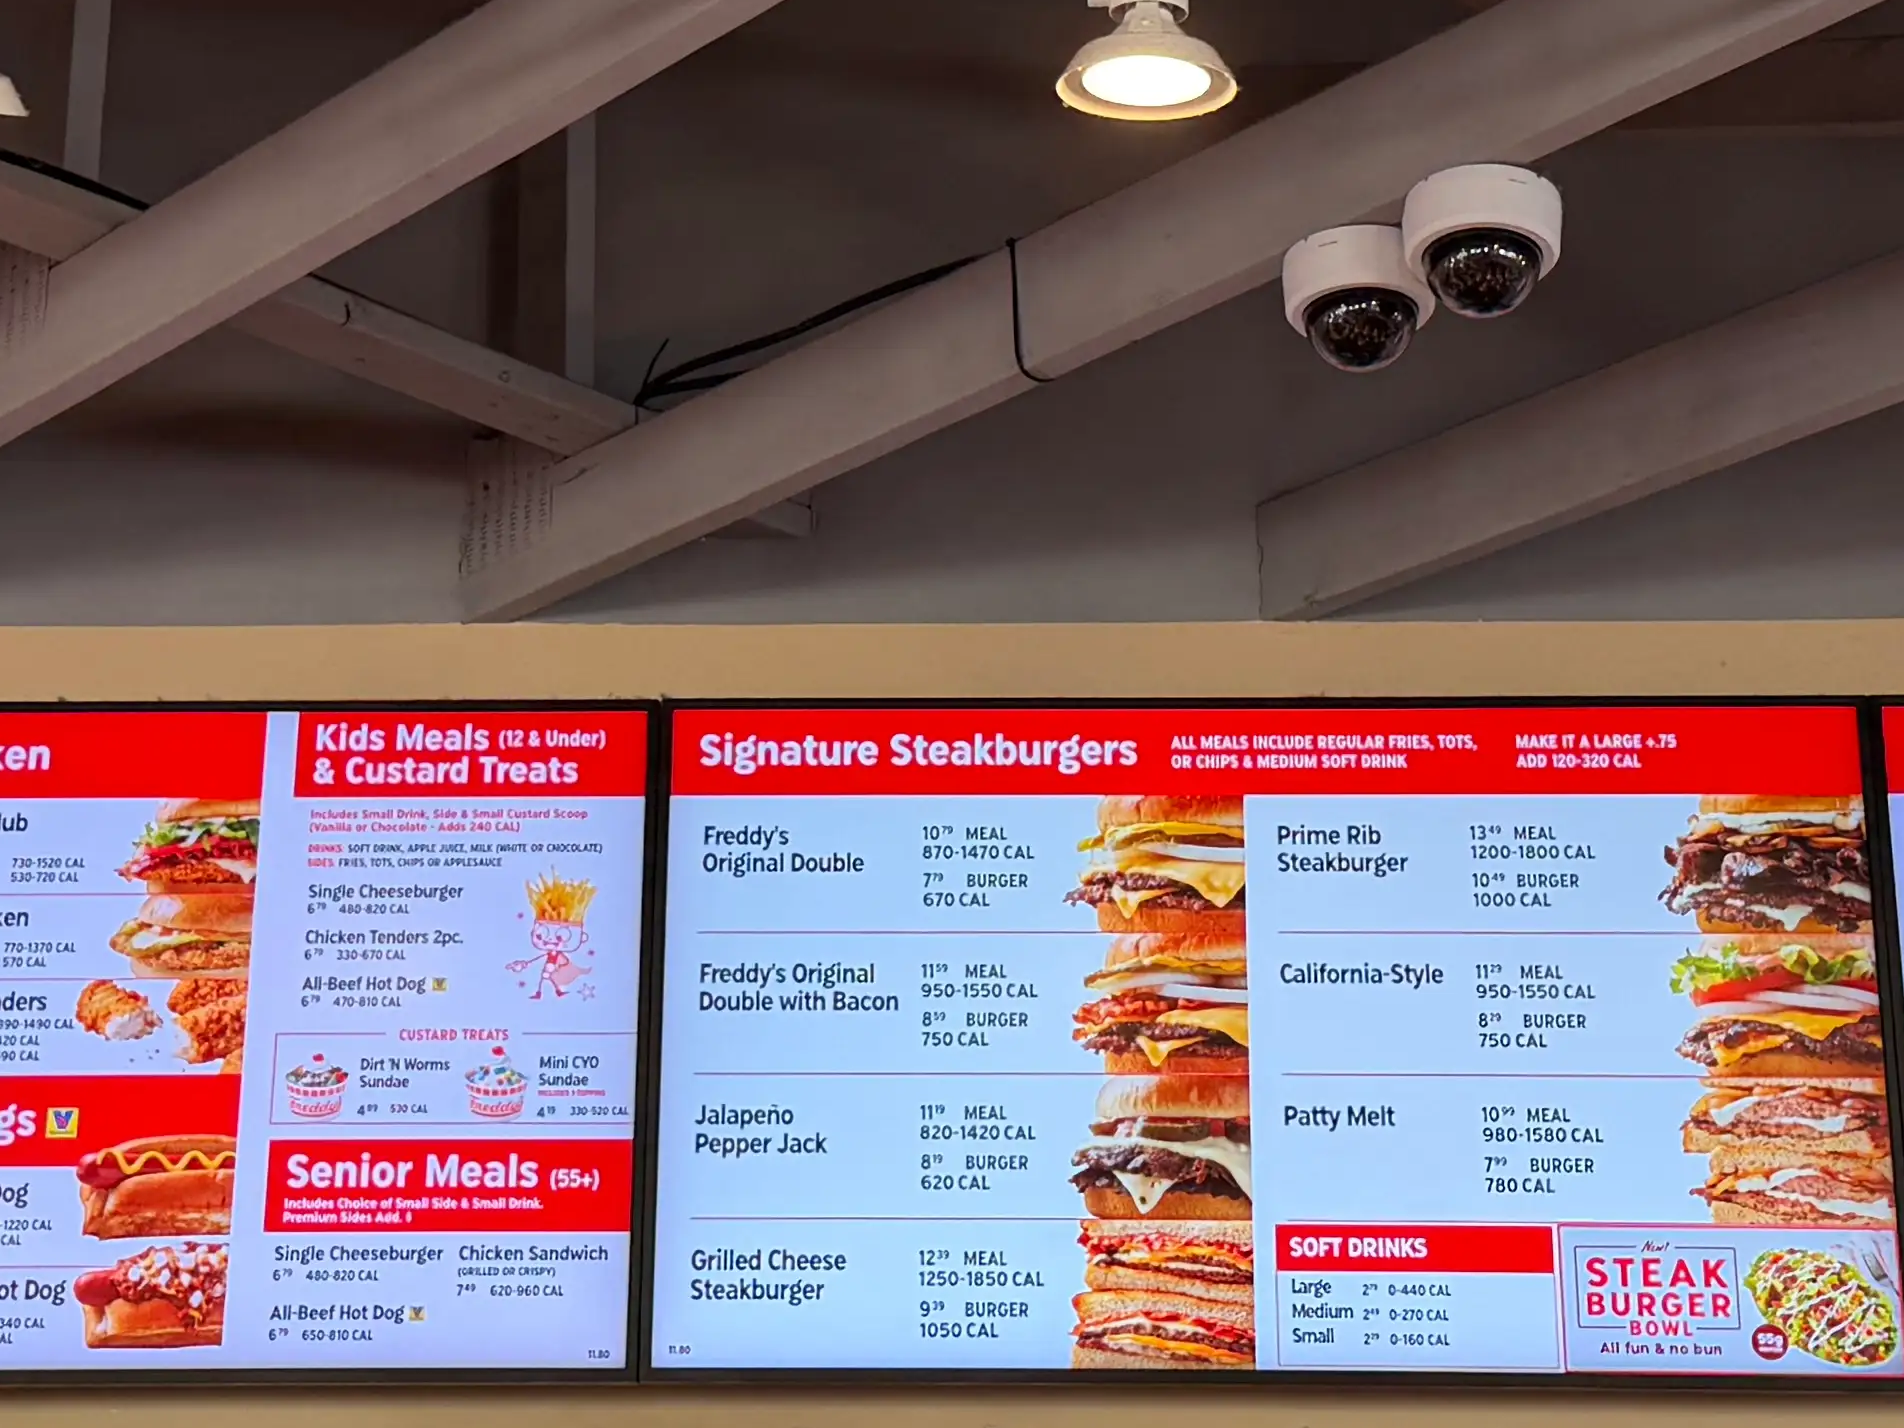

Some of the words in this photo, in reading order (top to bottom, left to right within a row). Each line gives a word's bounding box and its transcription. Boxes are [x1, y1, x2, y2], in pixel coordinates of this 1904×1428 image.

[317, 723, 384, 750] Kids
[397, 724, 489, 750] Meals
[700, 733, 878, 775] Signature
[890, 733, 1137, 774] Steakburgers
[314, 758, 334, 784] &
[346, 756, 468, 783] Custard
[480, 757, 577, 783] Treats
[704, 826, 788, 850] Freddy's
[1278, 825, 1340, 844] Prime
[1348, 825, 1381, 844] Rib
[703, 852, 783, 877] Original
[792, 853, 864, 872] Double
[923, 845, 999, 859] 870-1470
[1004, 845, 1034, 859] CAL
[1278, 852, 1408, 877] Steakburger
[967, 874, 1027, 887] BURGER
[1280, 963, 1443, 989] California-Style
[695, 1104, 793, 1129] Jalapeño
[1285, 1106, 1340, 1132] Patty
[1348, 1106, 1395, 1126] Melt
[696, 1133, 772, 1158] Pepper
[777, 1133, 827, 1153] Jack
[288, 1153, 412, 1188] Senior
[426, 1154, 538, 1187] Meals
[550, 1169, 599, 1190] (55+)
[692, 1248, 761, 1270] Grilled
[769, 1249, 846, 1270] Cheese
[1290, 1237, 1342, 1256] SOFT
[1349, 1238, 1427, 1257] DRINKS
[1587, 1258, 1728, 1288] STEAK
[691, 1278, 824, 1306] Steakburger
[1587, 1292, 1730, 1317] BURGER
[1630, 1320, 1692, 1336] BOWL
